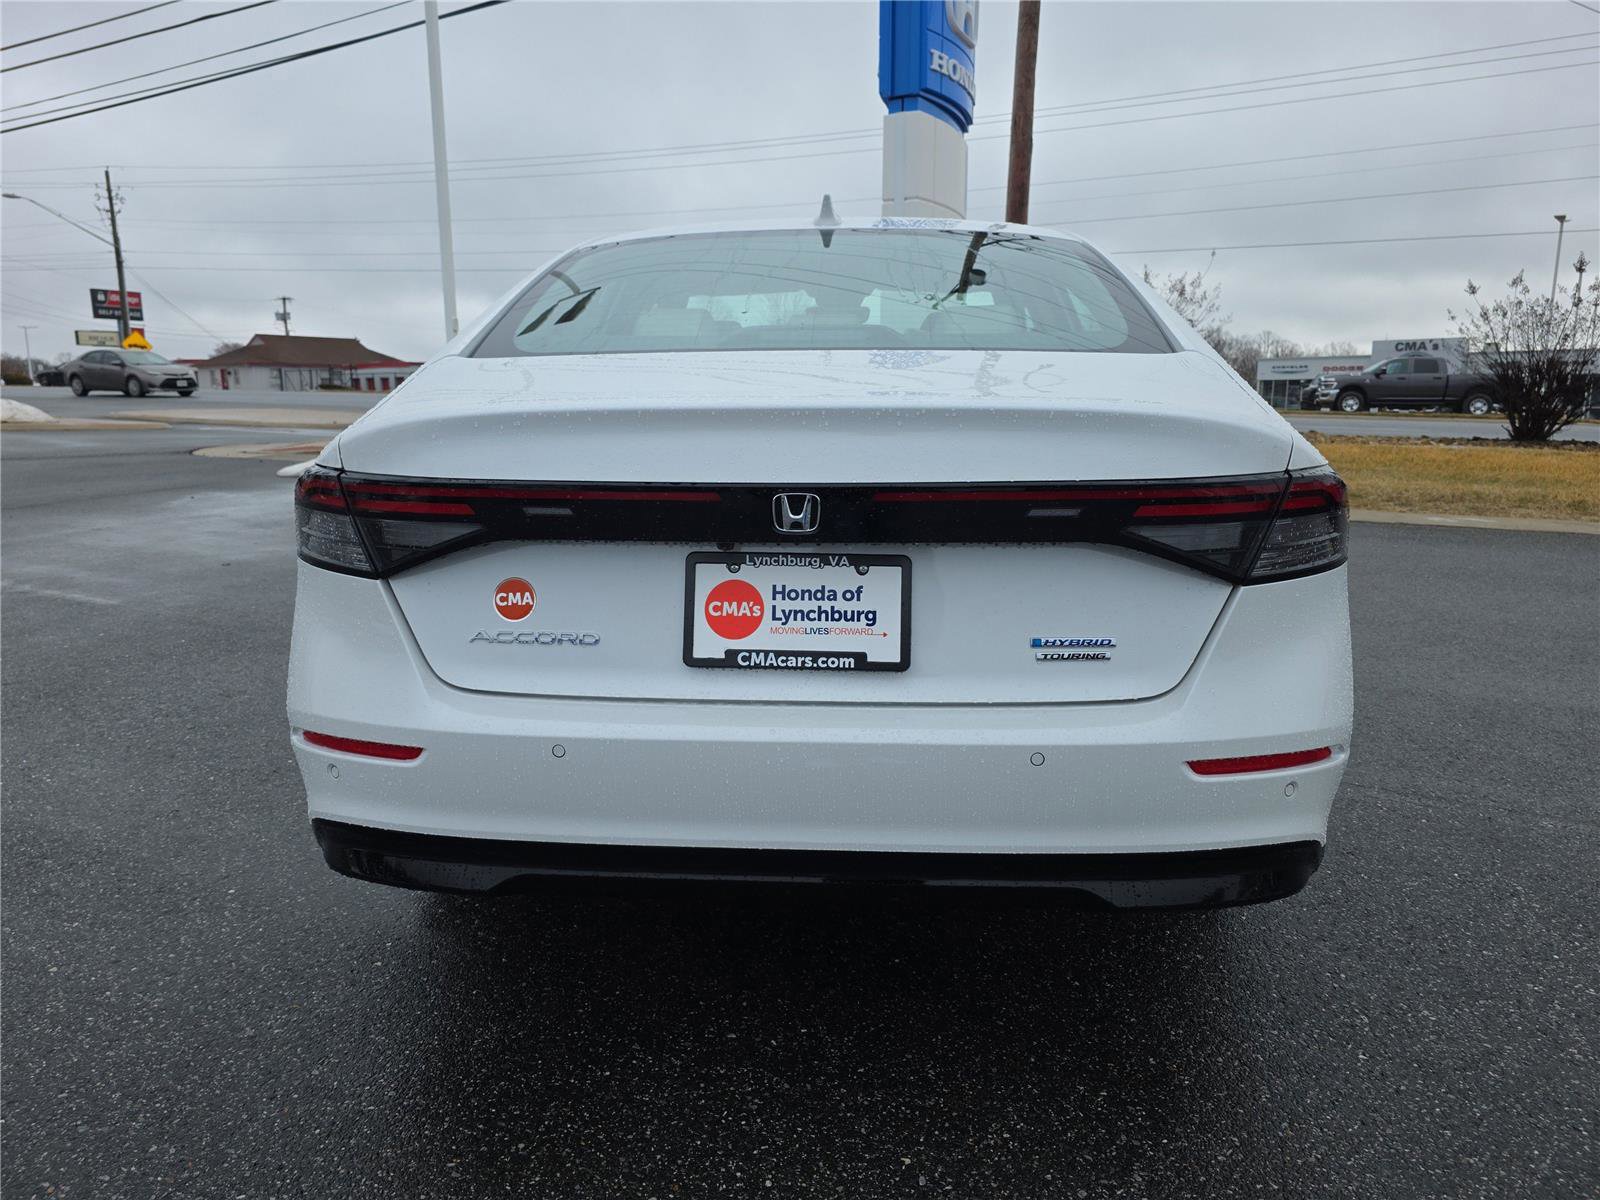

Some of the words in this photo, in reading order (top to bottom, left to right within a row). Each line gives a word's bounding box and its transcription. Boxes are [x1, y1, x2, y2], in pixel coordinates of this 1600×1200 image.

[1395, 339, 1439, 352] CMA's
[745, 555, 824, 569] Lynchburg,
[829, 556, 850, 567] VA
[495, 591, 534, 607] CMA
[772, 585, 838, 602] Honda
[842, 585, 863, 602] of
[708, 600, 761, 617] CMA's
[771, 605, 877, 626] Lynchburg
[469, 630, 601, 646] ACCORD
[1043, 638, 1113, 647] HYBRID
[737, 652, 855, 669] CMAcars.com
[1040, 652, 1107, 661] TOURING
